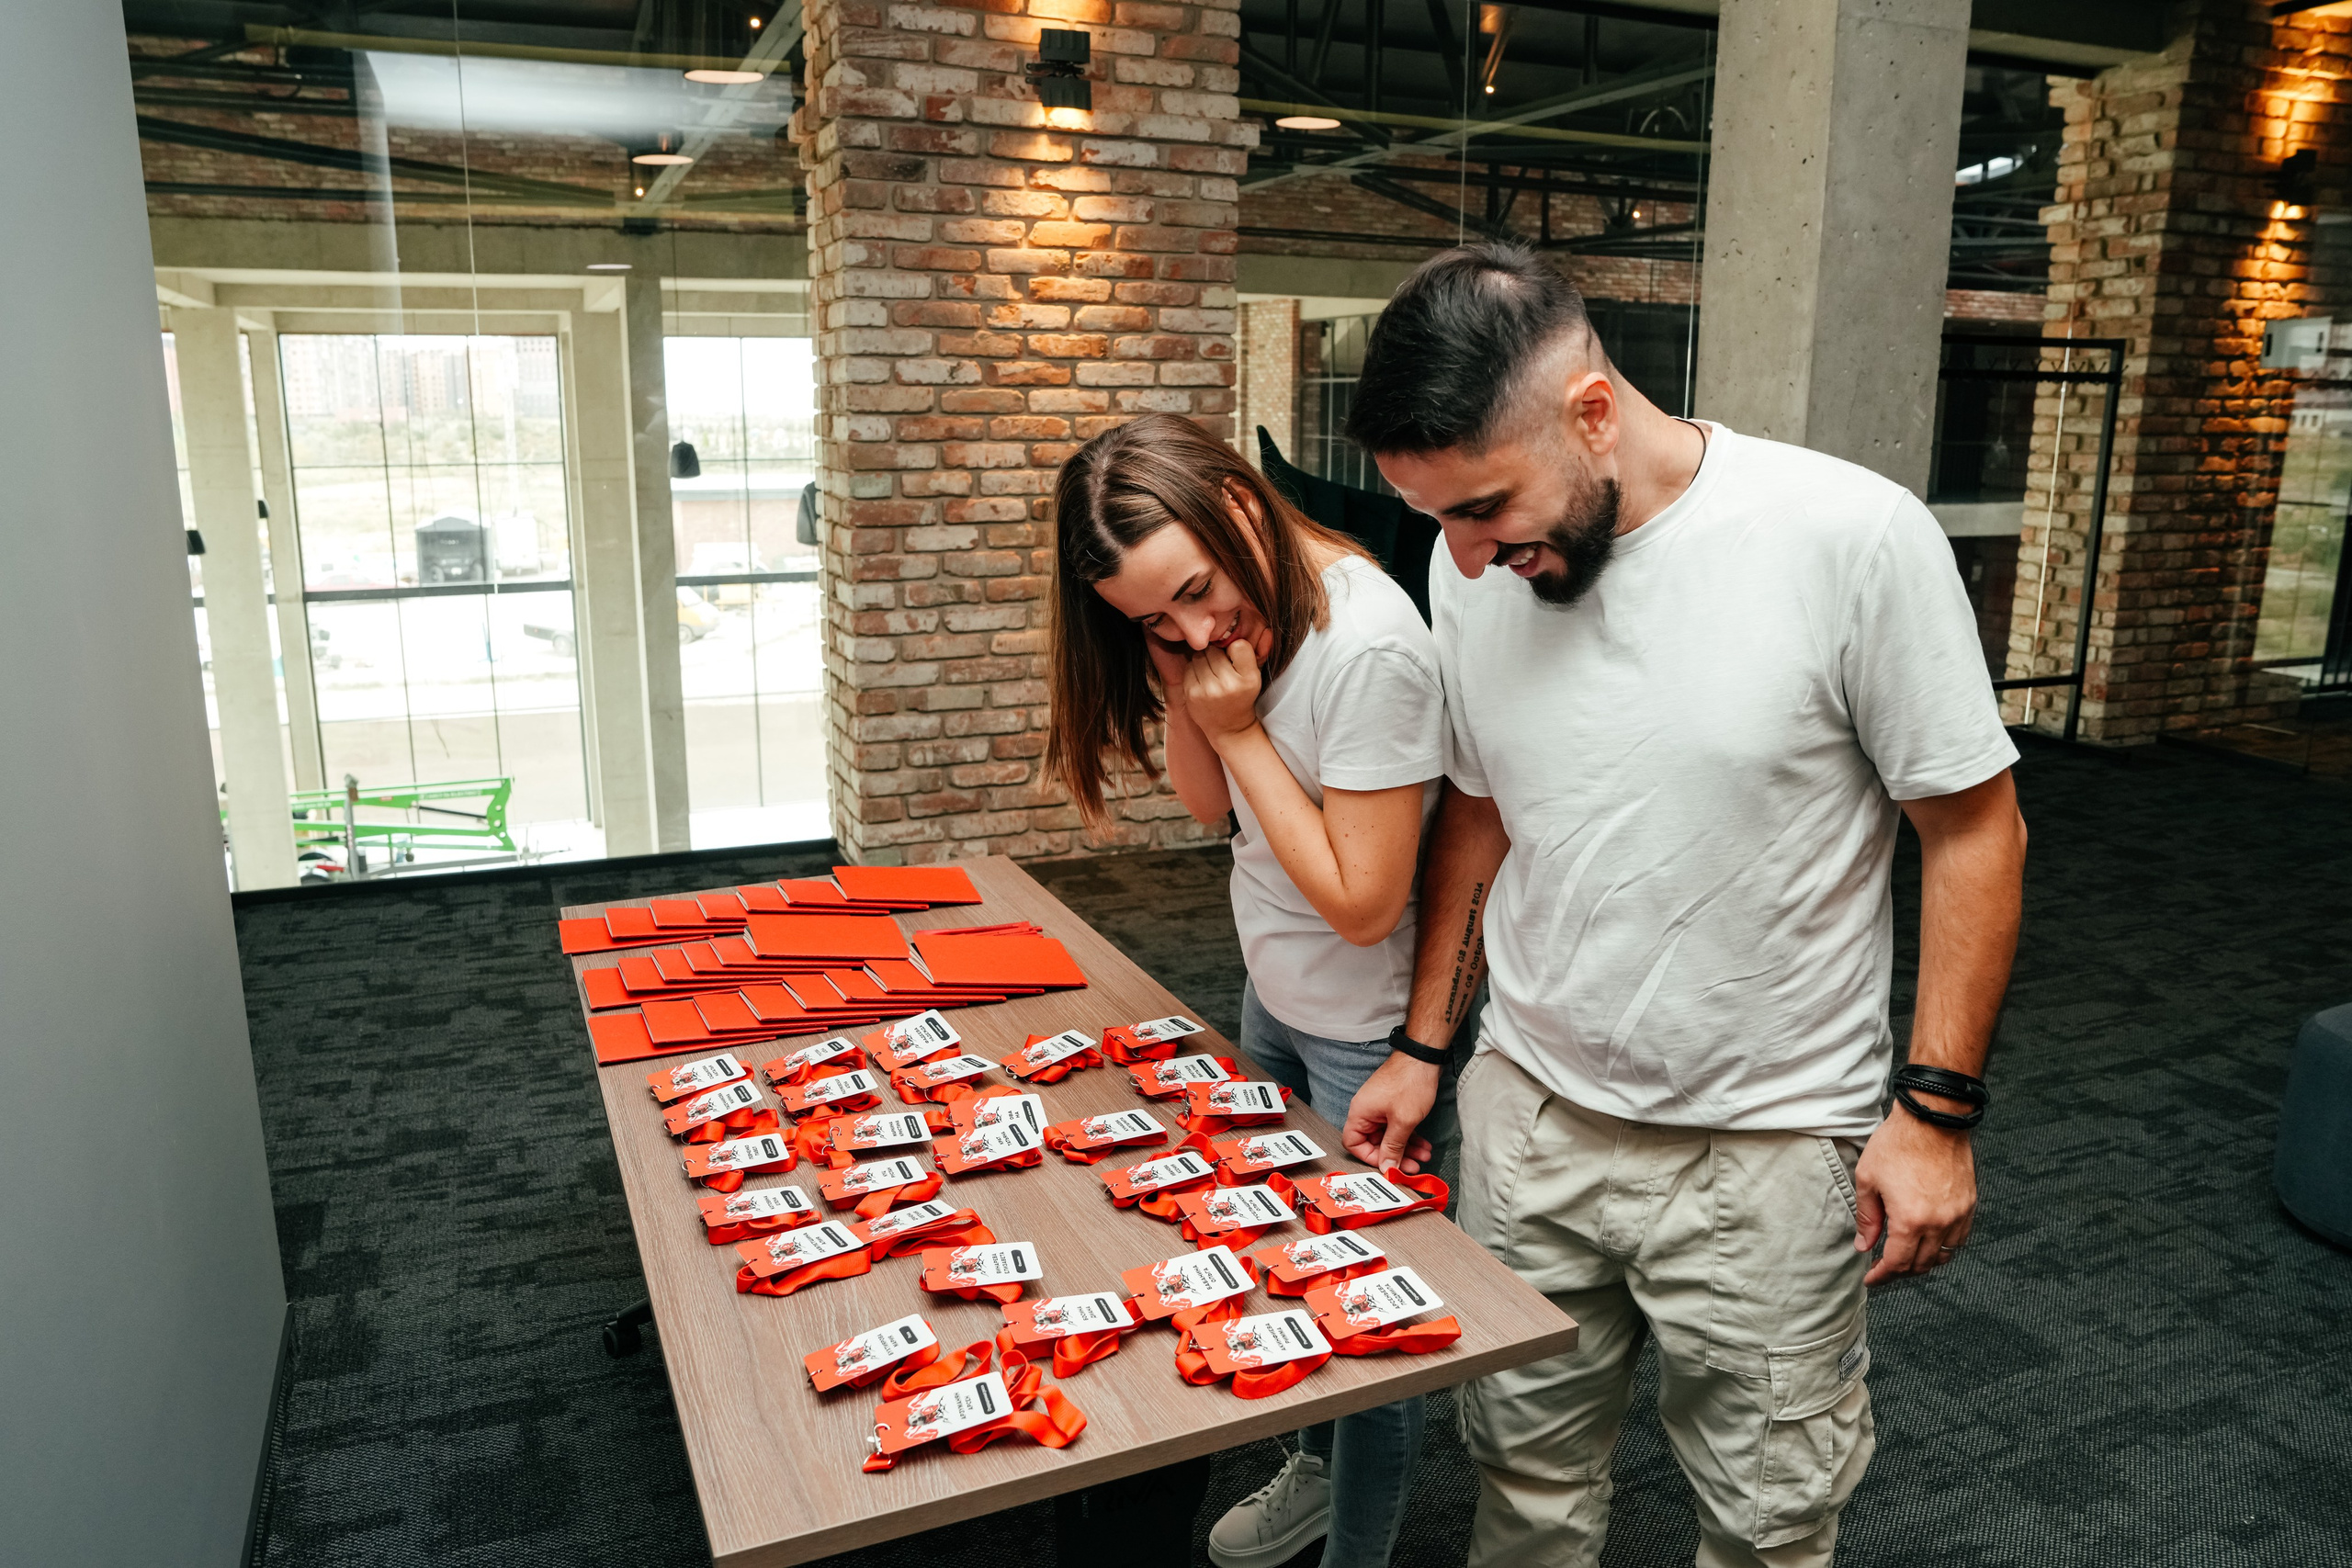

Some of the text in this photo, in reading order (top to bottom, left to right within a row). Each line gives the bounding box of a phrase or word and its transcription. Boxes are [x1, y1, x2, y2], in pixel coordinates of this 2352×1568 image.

[1445, 882, 1484, 1025] Alexander 02 August 2014
[1465, 974, 1474, 988] 09
[1471, 935, 1485, 970] Octob
[913, 1027, 930, 1043] ФАДЕЕВА
[918, 1025, 935, 1042] НАДЕЖДА
[1001, 1131, 1012, 1146] ТАТЬЯНА
[1281, 1142, 1294, 1153] ЕЛЕНА
[1362, 1183, 1382, 1199] МАРИНА
[1248, 1199, 1261, 1212] ОЛЬГА
[802, 1232, 825, 1253] ДАВЛЕТШИНА
[815, 1236, 827, 1245] АЛИЯ
[991, 1253, 1001, 1273] ВИНАРЕВА
[999, 1252, 1010, 1274] ЕЛИЗАВЕТА
[1192, 1264, 1213, 1290] БАБАНИНА
[1203, 1267, 1216, 1282] ОЛЬГА
[1375, 1283, 1401, 1310] АРСЕНЬЕВА
[1384, 1283, 1407, 1306] ЛЮДМИЛА
[1084, 1306, 1096, 1318] ДИАНА
[888, 1335, 899, 1348] МАРИЯ
[1264, 1323, 1287, 1351] АКИНФИЕВА
[1276, 1327, 1291, 1344] РИММА
[876, 1333, 894, 1356] БУХТИЯРОВА
[954, 1392, 967, 1419] АРЗУМАНЯН
[965, 1394, 974, 1410] АРСЕН
